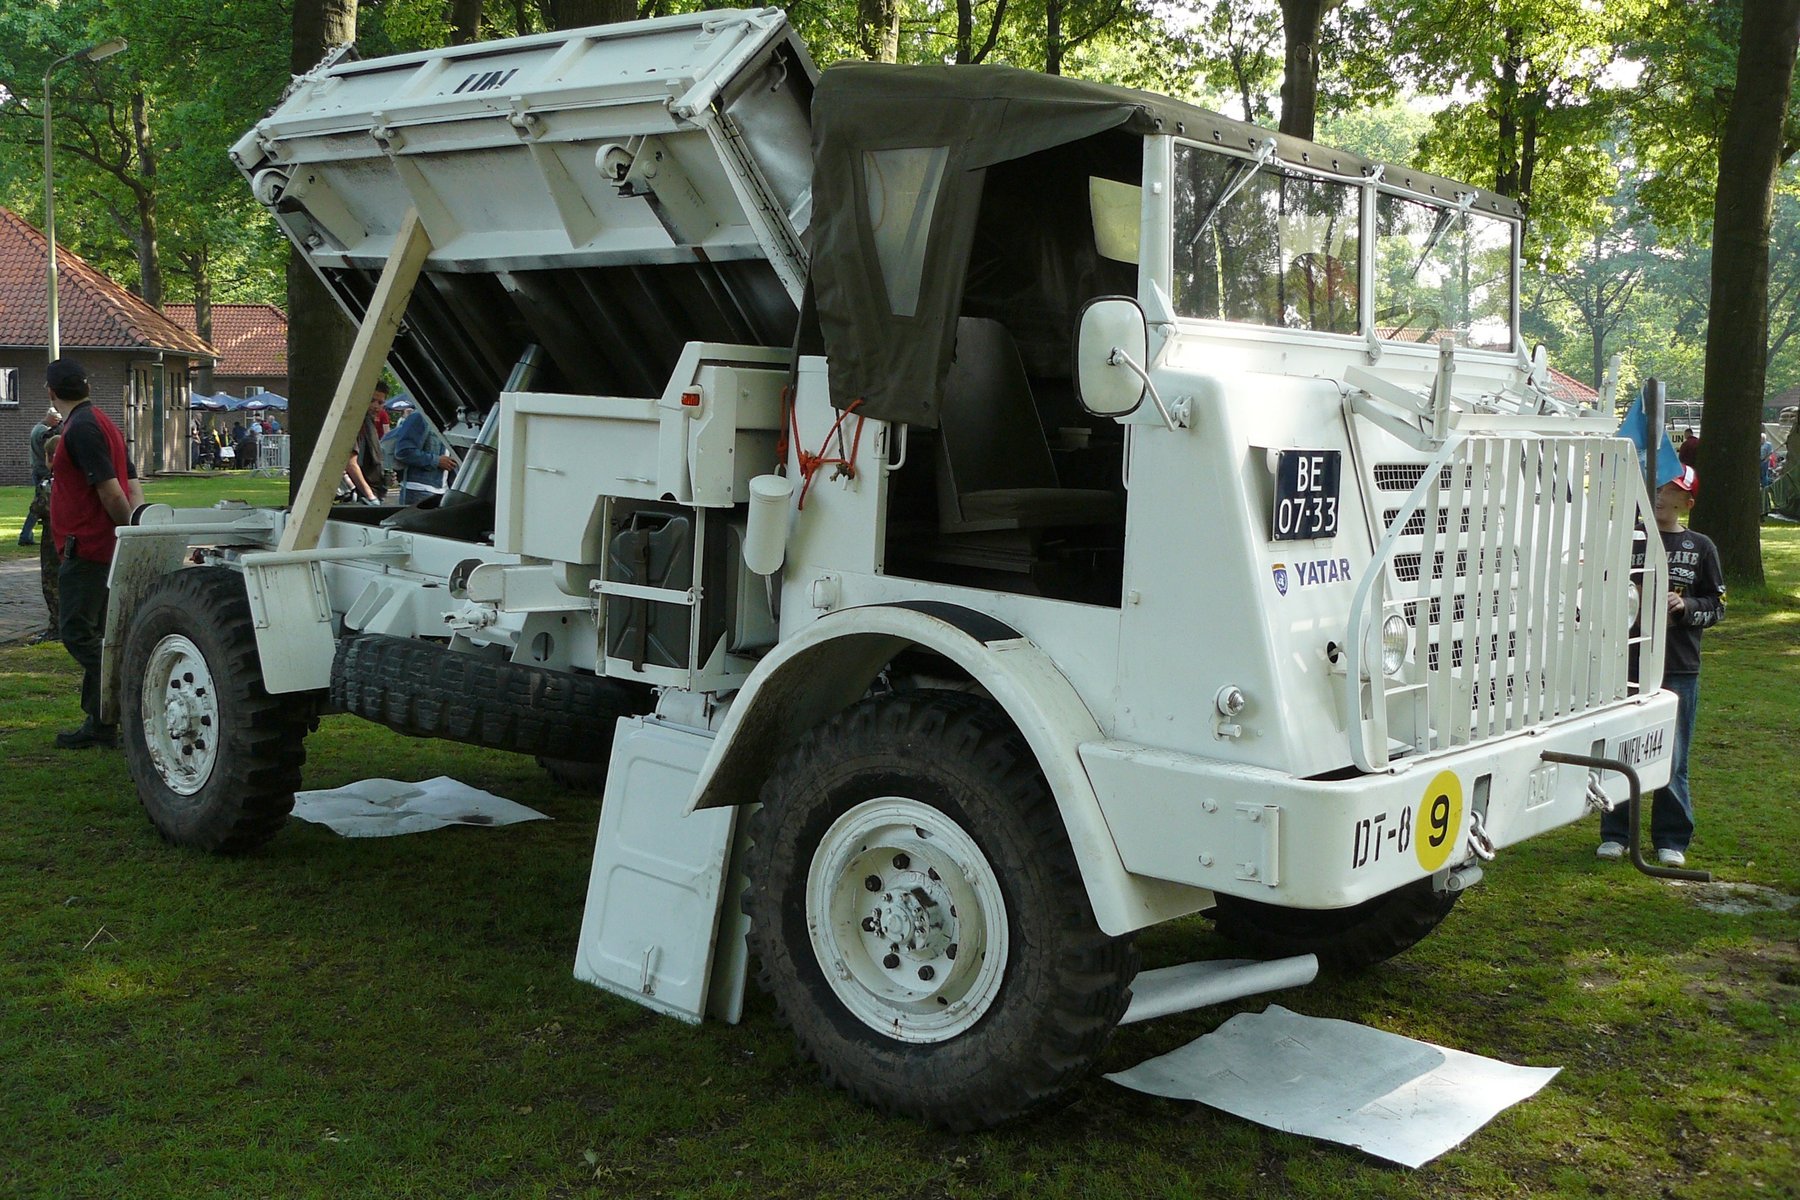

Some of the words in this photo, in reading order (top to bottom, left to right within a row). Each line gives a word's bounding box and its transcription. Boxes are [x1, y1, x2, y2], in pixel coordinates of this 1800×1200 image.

[1671, 434, 1684, 443] UN
[1296, 456, 1324, 492] BE
[1294, 558, 1352, 587] YATAR
[1352, 805, 1411, 869] DT-8
[1428, 794, 1450, 848] 9
